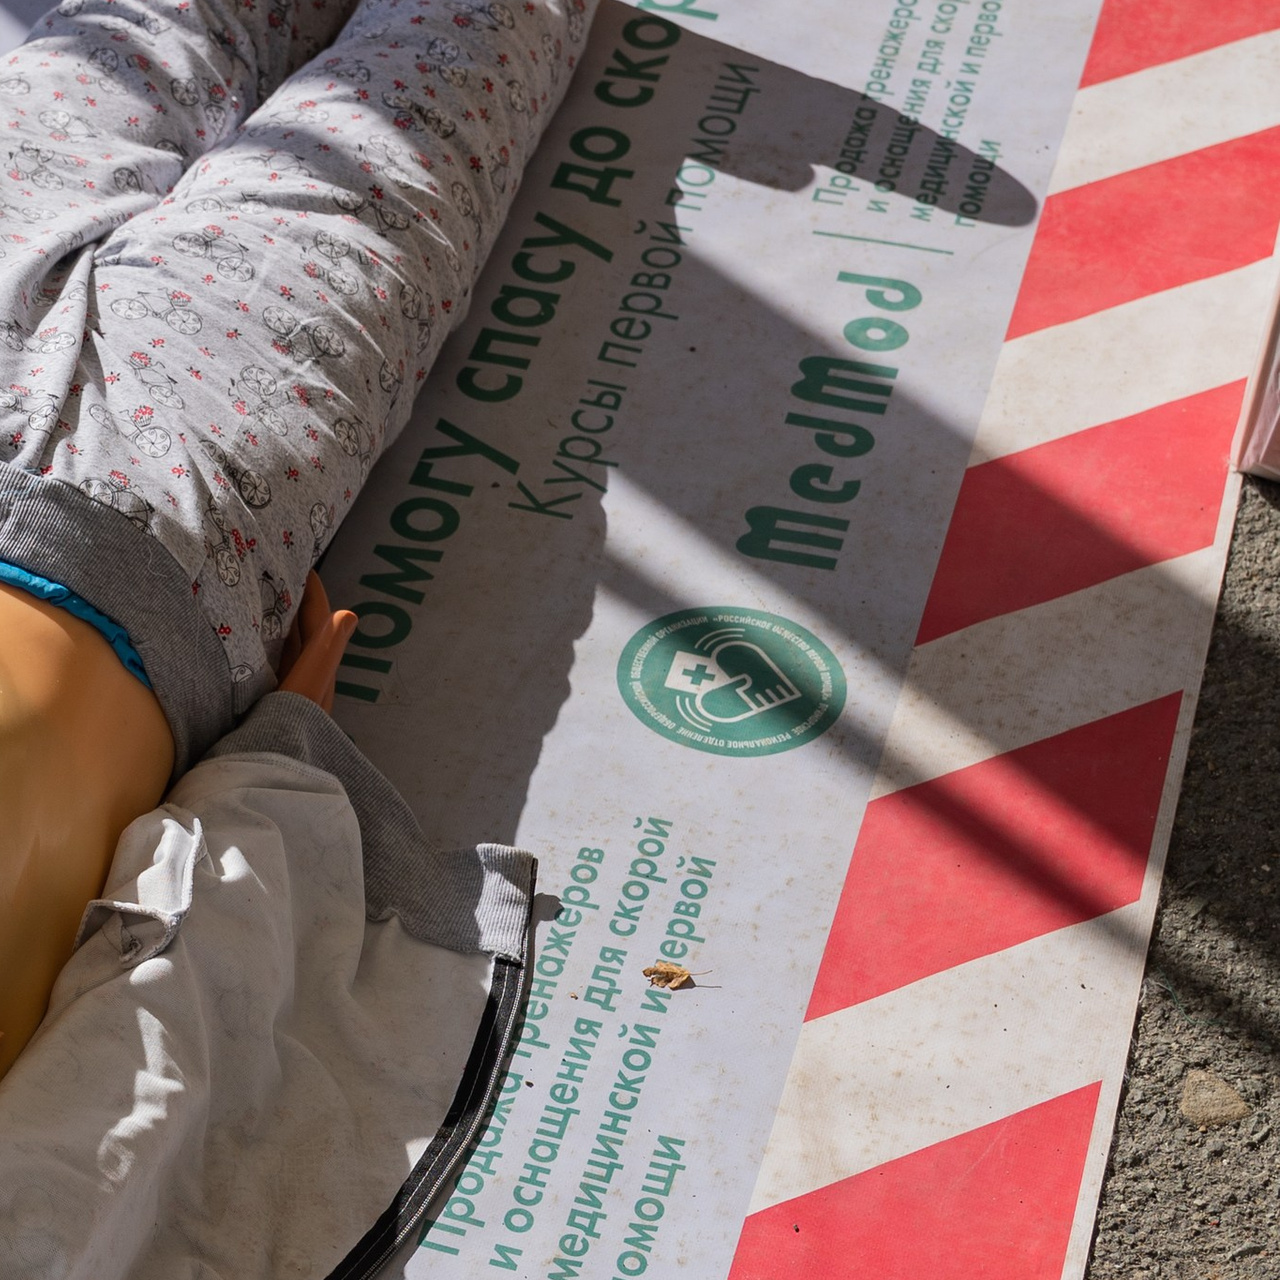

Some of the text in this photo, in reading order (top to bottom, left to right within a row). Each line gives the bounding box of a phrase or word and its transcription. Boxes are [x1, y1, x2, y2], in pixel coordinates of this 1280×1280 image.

[917, 39, 946, 75] для
[812, 105, 878, 206] Продажа
[874, 78, 932, 193] оснащения
[910, 80, 976, 223] медицинской
[959, 61, 982, 76] и
[955, 138, 1002, 229] помощи
[866, 199, 891, 215] и
[455, 211, 614, 404] спасу
[550, 126, 636, 207] до
[508, 62, 761, 520] Курсы первой помощи
[735, 270, 923, 571] MedMod
[655, 855, 717, 970] ервой
[417, 846, 605, 1256] Продажа тренажеров
[489, 816, 673, 1271] и оснащения для скорой
[640, 988, 673, 1014] и
